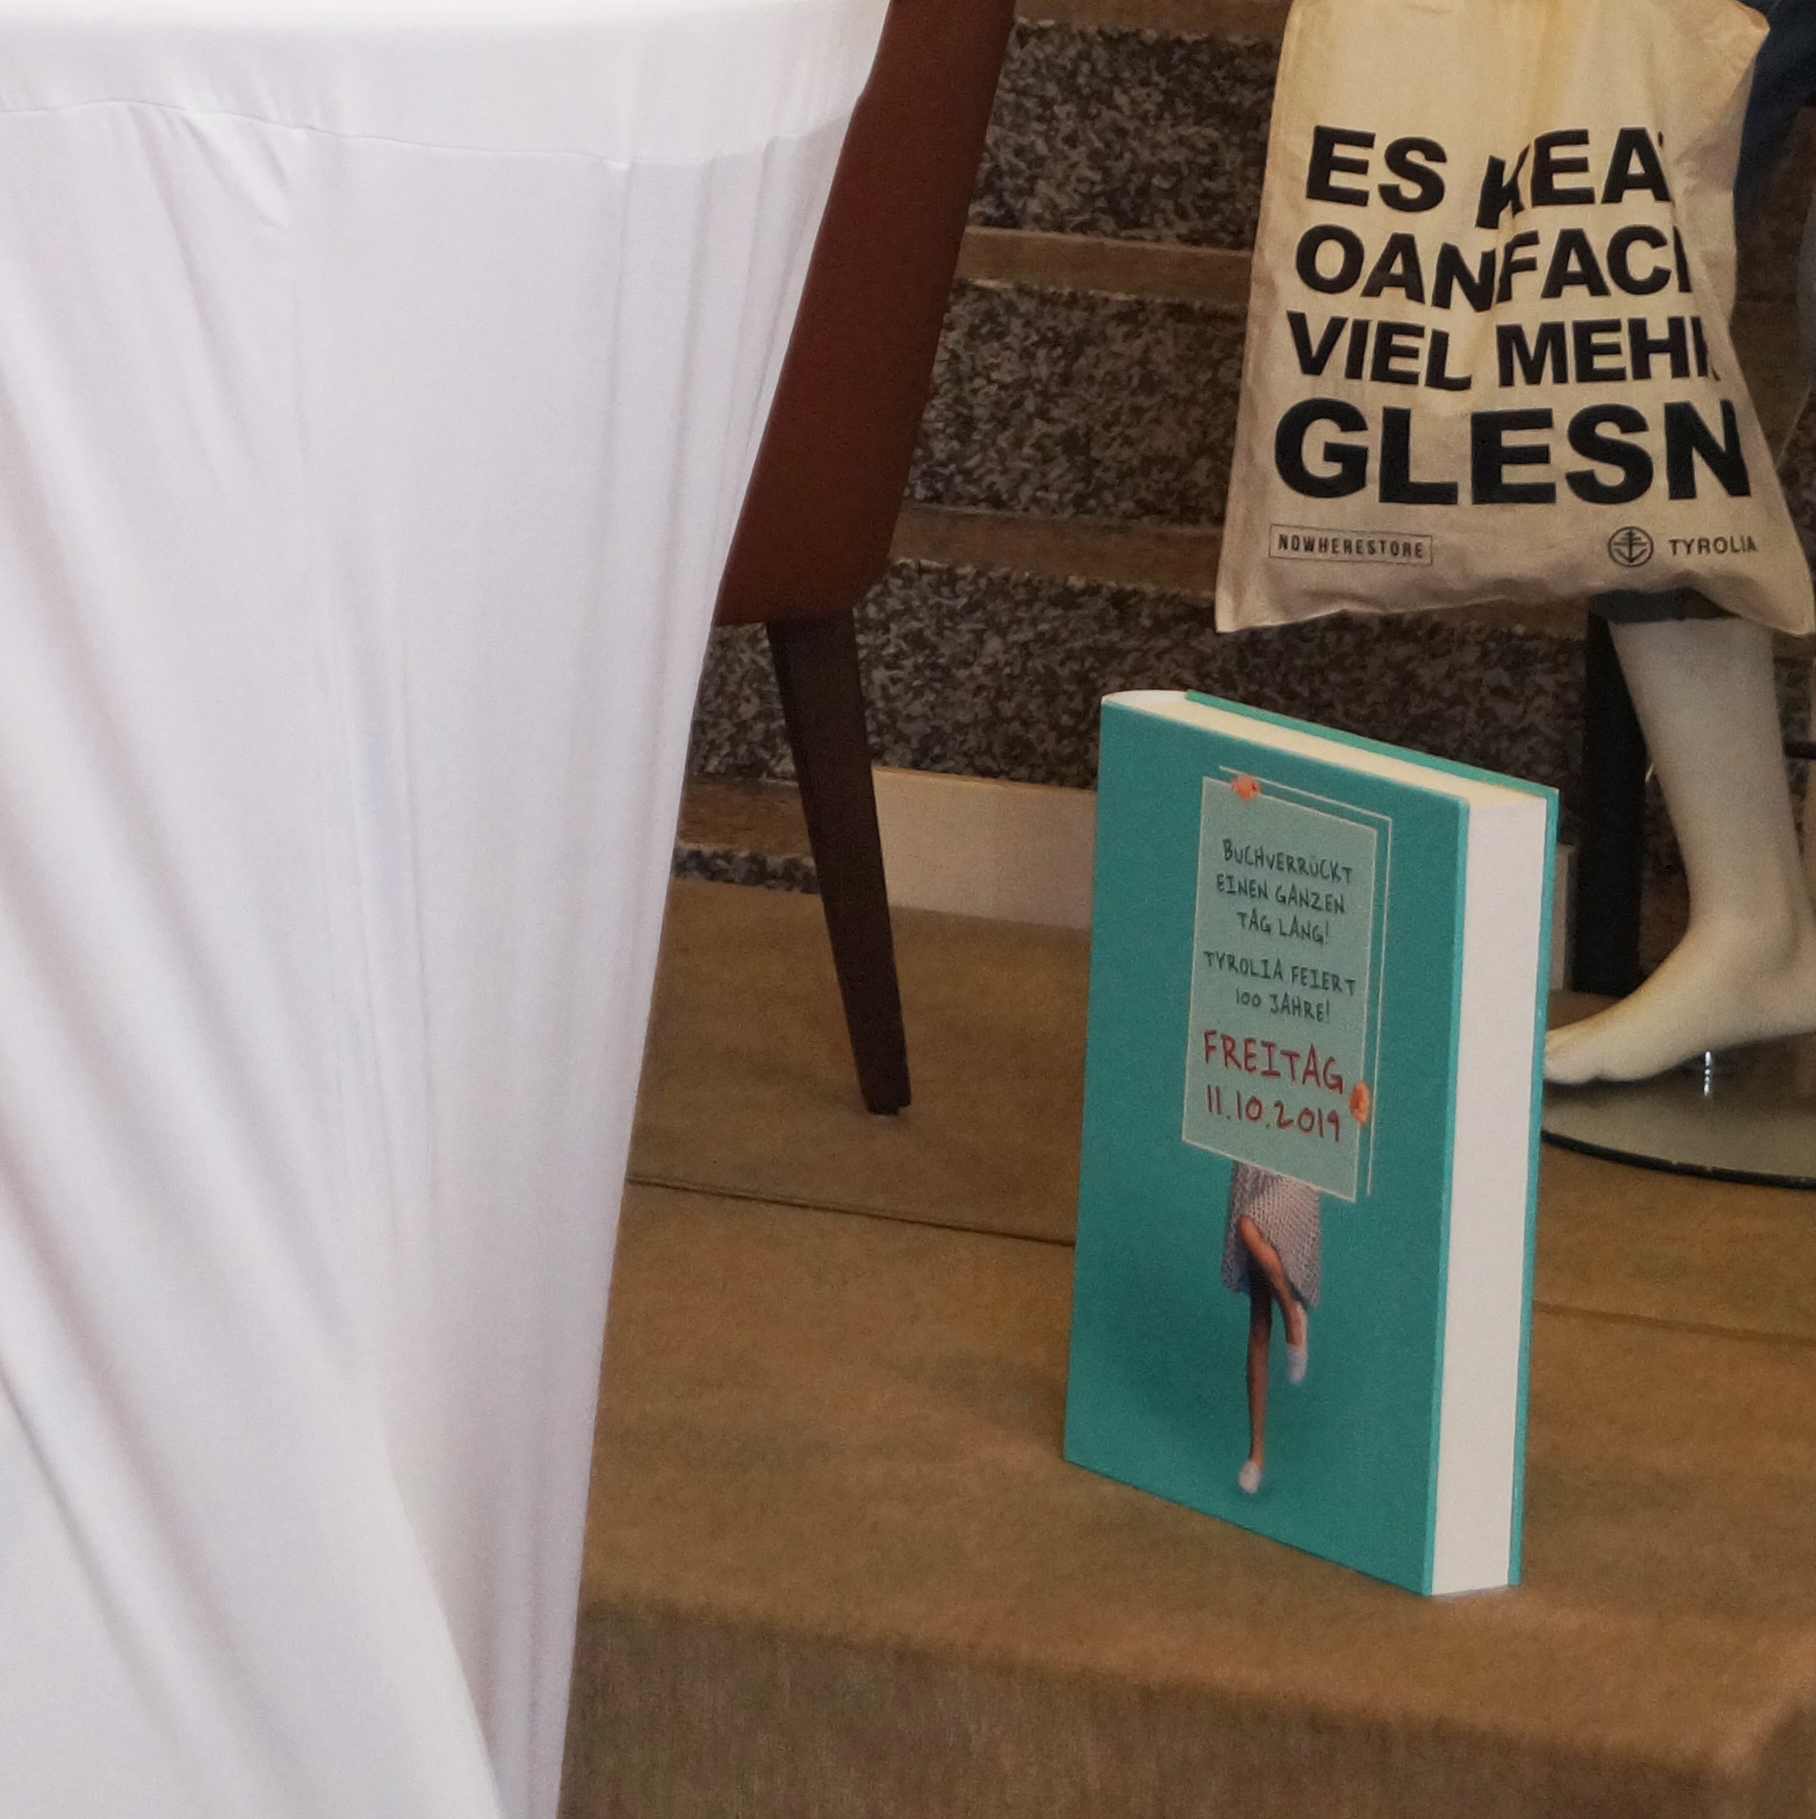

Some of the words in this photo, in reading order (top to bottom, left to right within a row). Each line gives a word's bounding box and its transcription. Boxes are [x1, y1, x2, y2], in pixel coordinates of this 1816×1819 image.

[1305, 124, 1446, 213] ES
[1286, 309, 1474, 392] VIEL
[1273, 397, 1753, 506] GLESN
[1277, 532, 1425, 560] NOWHERESTORE
[1668, 536, 1758, 557] TYROLIA
[1222, 838, 1353, 885] BUCHVERRÜCKT
[1216, 873, 1268, 900] EINEN
[1274, 884, 1345, 914] GANZEN
[1237, 911, 1272, 935] TAG
[1278, 918, 1330, 945] LANG!
[1203, 951, 1284, 981] TYROLIA
[1290, 965, 1357, 997] FEIERT
[1269, 994, 1330, 1023] JAHRE!
[1203, 1029, 1345, 1095] FREITAG
[1206, 1085, 1341, 1142] 11.10.2019
